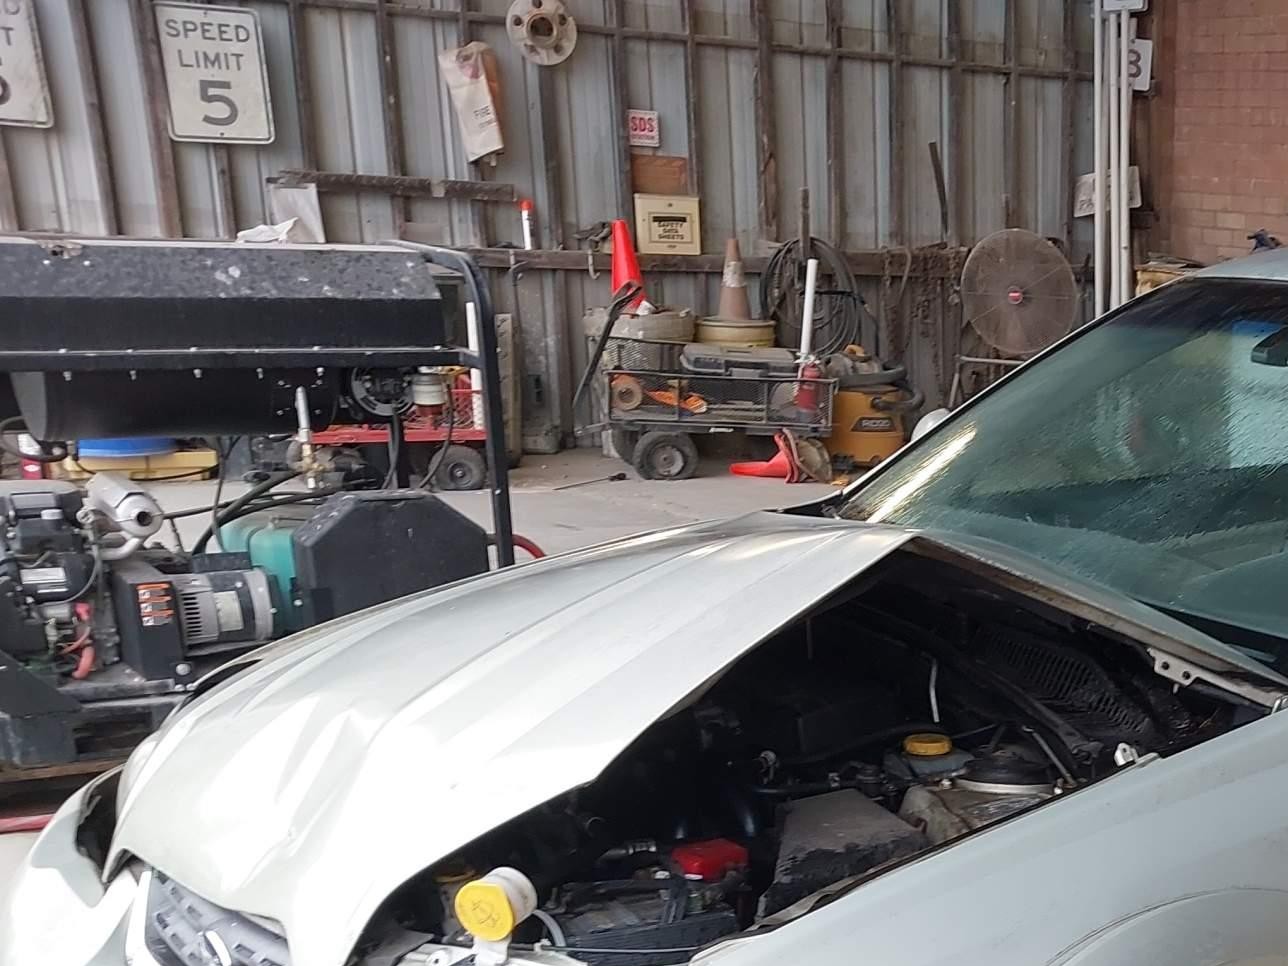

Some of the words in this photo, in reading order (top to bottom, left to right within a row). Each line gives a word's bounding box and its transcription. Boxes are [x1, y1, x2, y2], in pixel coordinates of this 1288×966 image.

[165, 19, 250, 43] SPEED
[177, 48, 244, 71] LIMIT
[199, 79, 239, 126] 5
[631, 116, 655, 132] SDS
